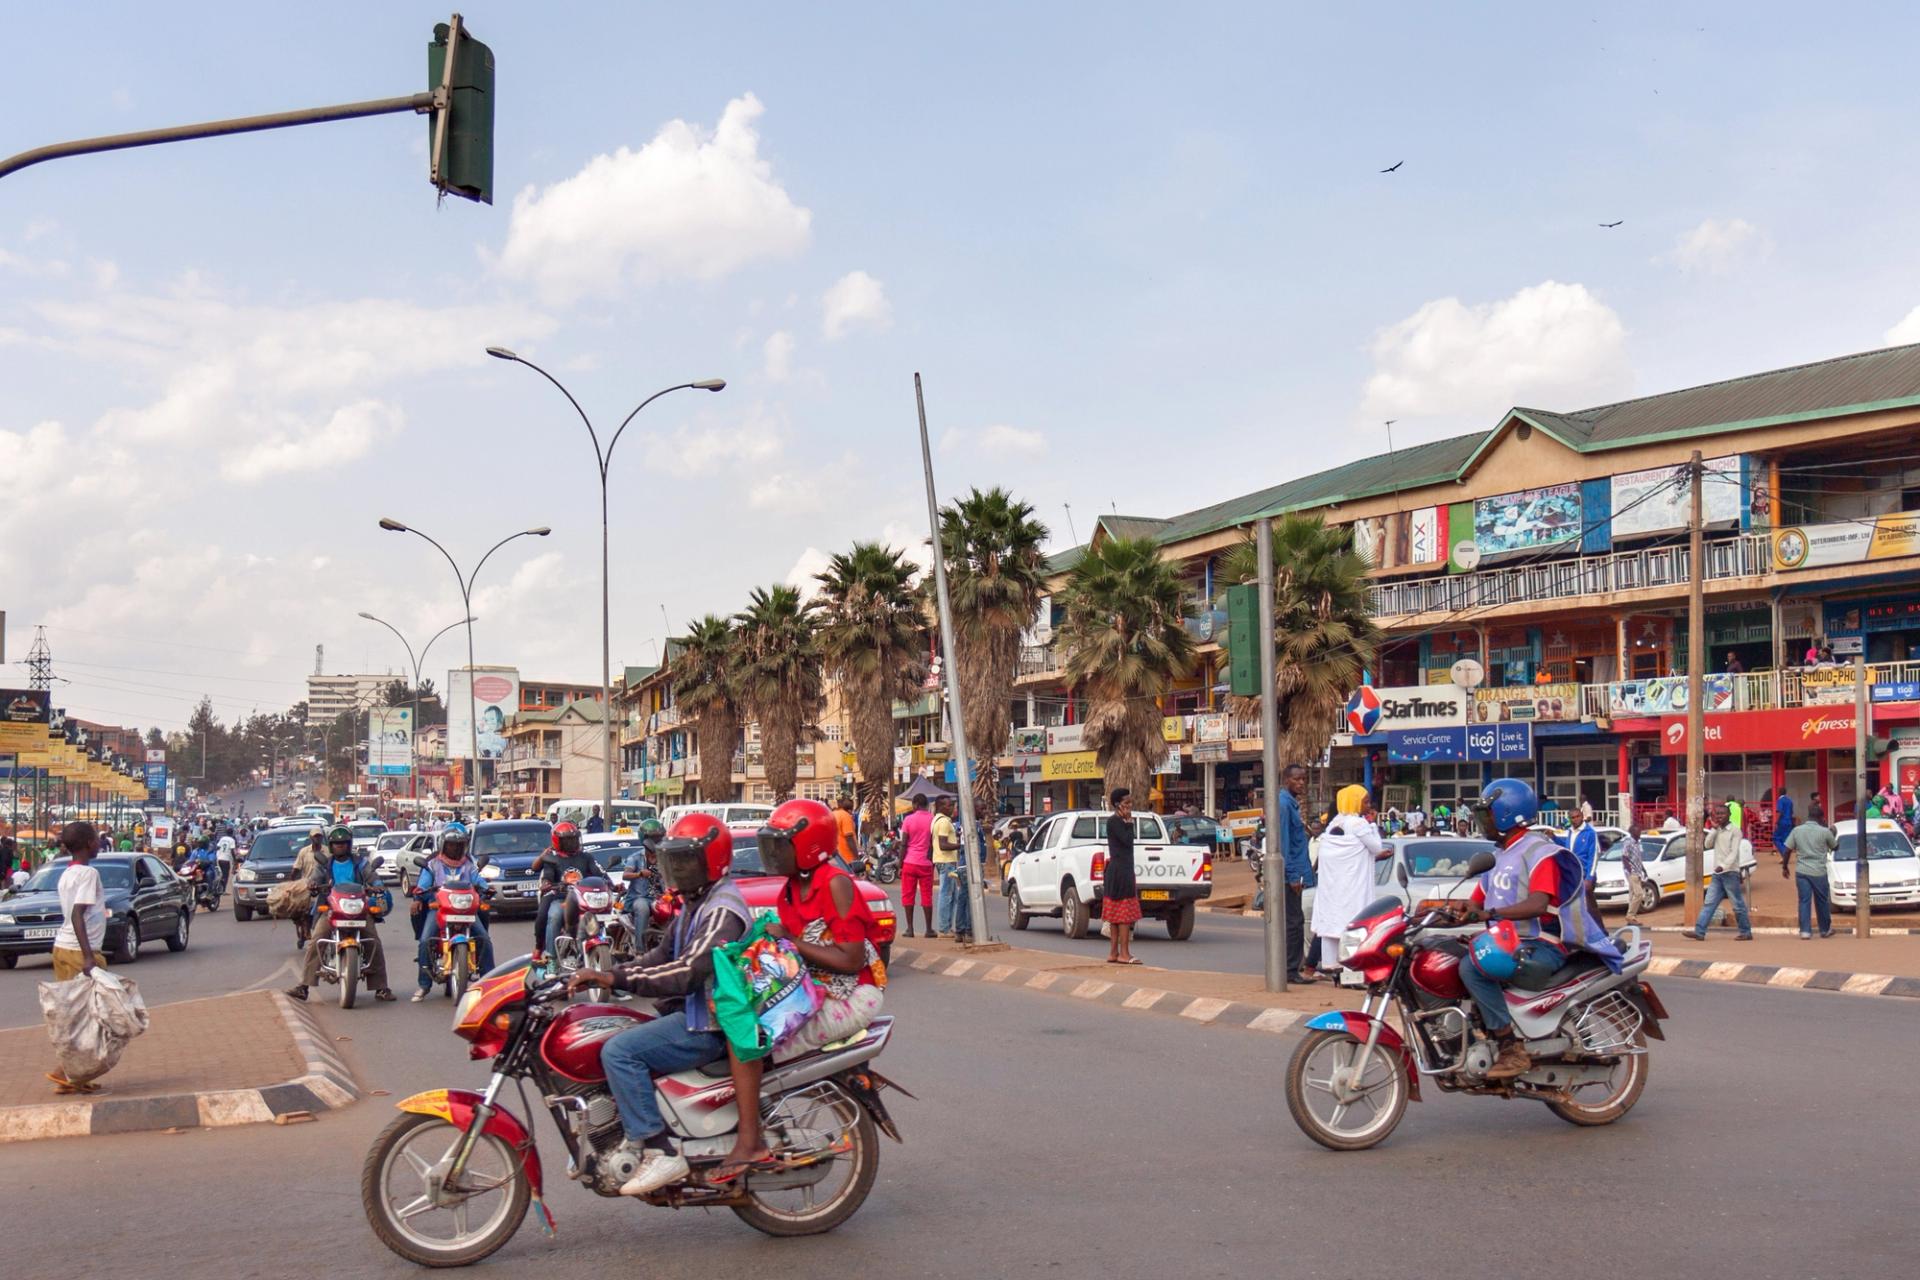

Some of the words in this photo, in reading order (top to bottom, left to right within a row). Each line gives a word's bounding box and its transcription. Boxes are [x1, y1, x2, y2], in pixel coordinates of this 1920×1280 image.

[1802, 670, 1867, 683] STUDIO-PHOO
[1476, 688, 1527, 701] ORANGE
[1533, 684, 1576, 699] SALON
[1383, 698, 1457, 718] StarTimes
[1403, 735, 1427, 745] Service
[1428, 734, 1451, 744] Centre
[1501, 733, 1515, 741] Live
[1501, 743, 1518, 751] Love
[1052, 760, 1072, 775] Service
[1073, 758, 1094, 774] Centre
[1134, 865, 1186, 877] OYOTA
